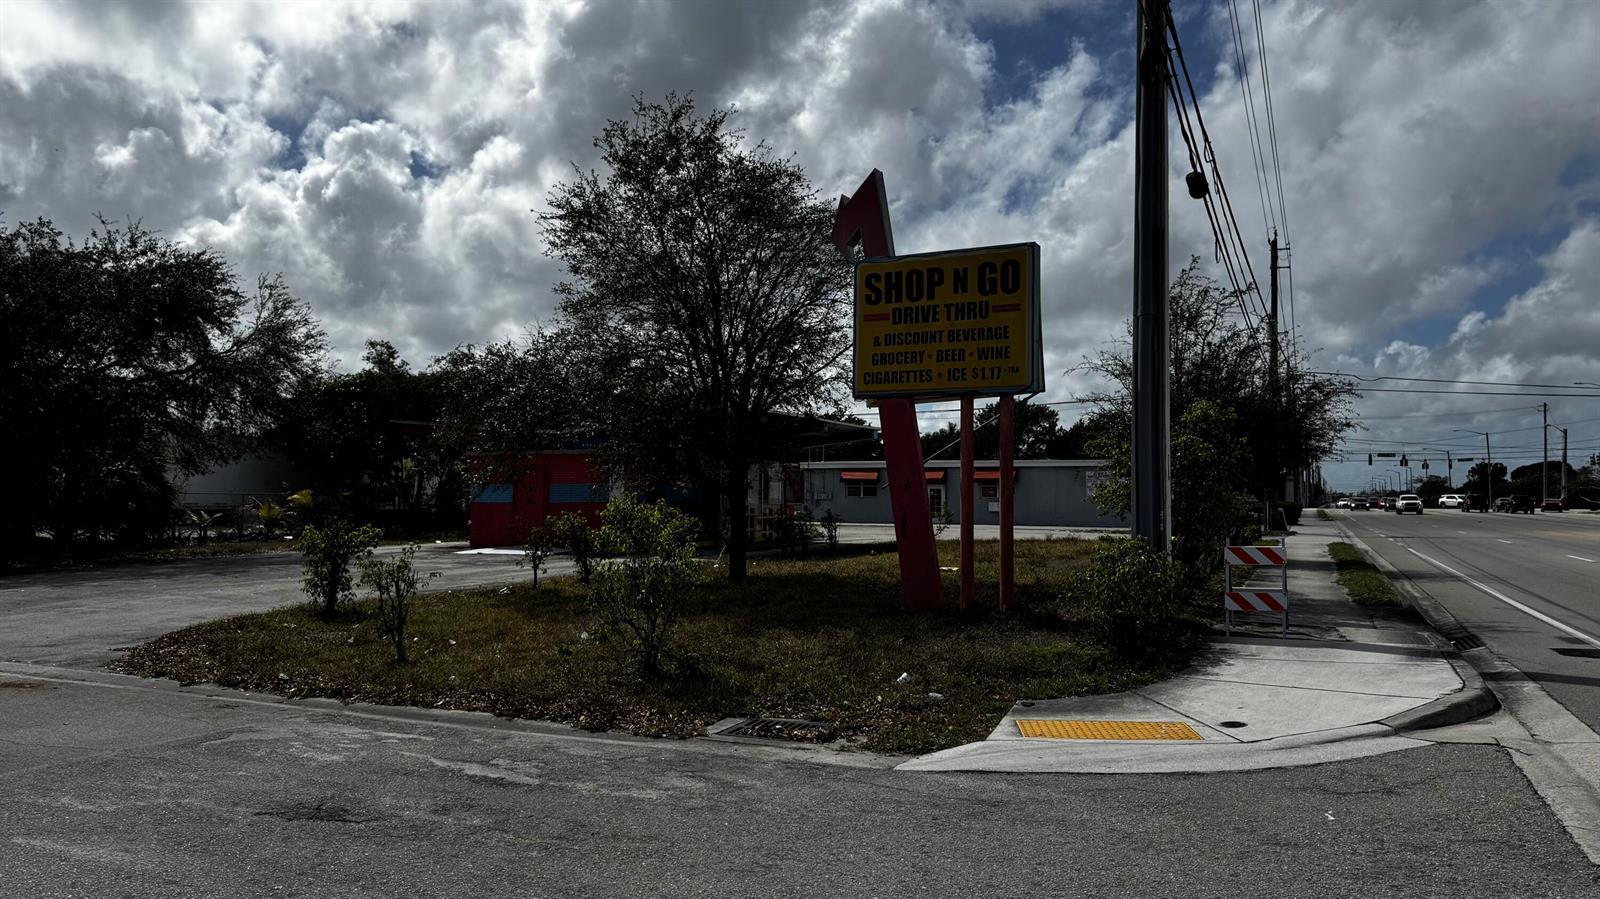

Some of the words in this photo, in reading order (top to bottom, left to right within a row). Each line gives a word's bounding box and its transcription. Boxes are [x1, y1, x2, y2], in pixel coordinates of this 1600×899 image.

[864, 267, 945, 306] SHOP
[953, 267, 968, 294] N
[977, 259, 1021, 296] GO
[892, 303, 940, 325] DRIVE
[944, 301, 989, 322] THRU
[873, 335, 881, 347] &
[884, 330, 944, 346] DISCOUNT
[948, 326, 1009, 343] BEVERAGE
[871, 350, 925, 366] GROCERY
[936, 349, 966, 363] BEER
[977, 345, 1010, 361] WINE
[863, 369, 933, 385] CIGARETTES
[947, 367, 967, 382] ICE
[972, 366, 1001, 381] $1.17
